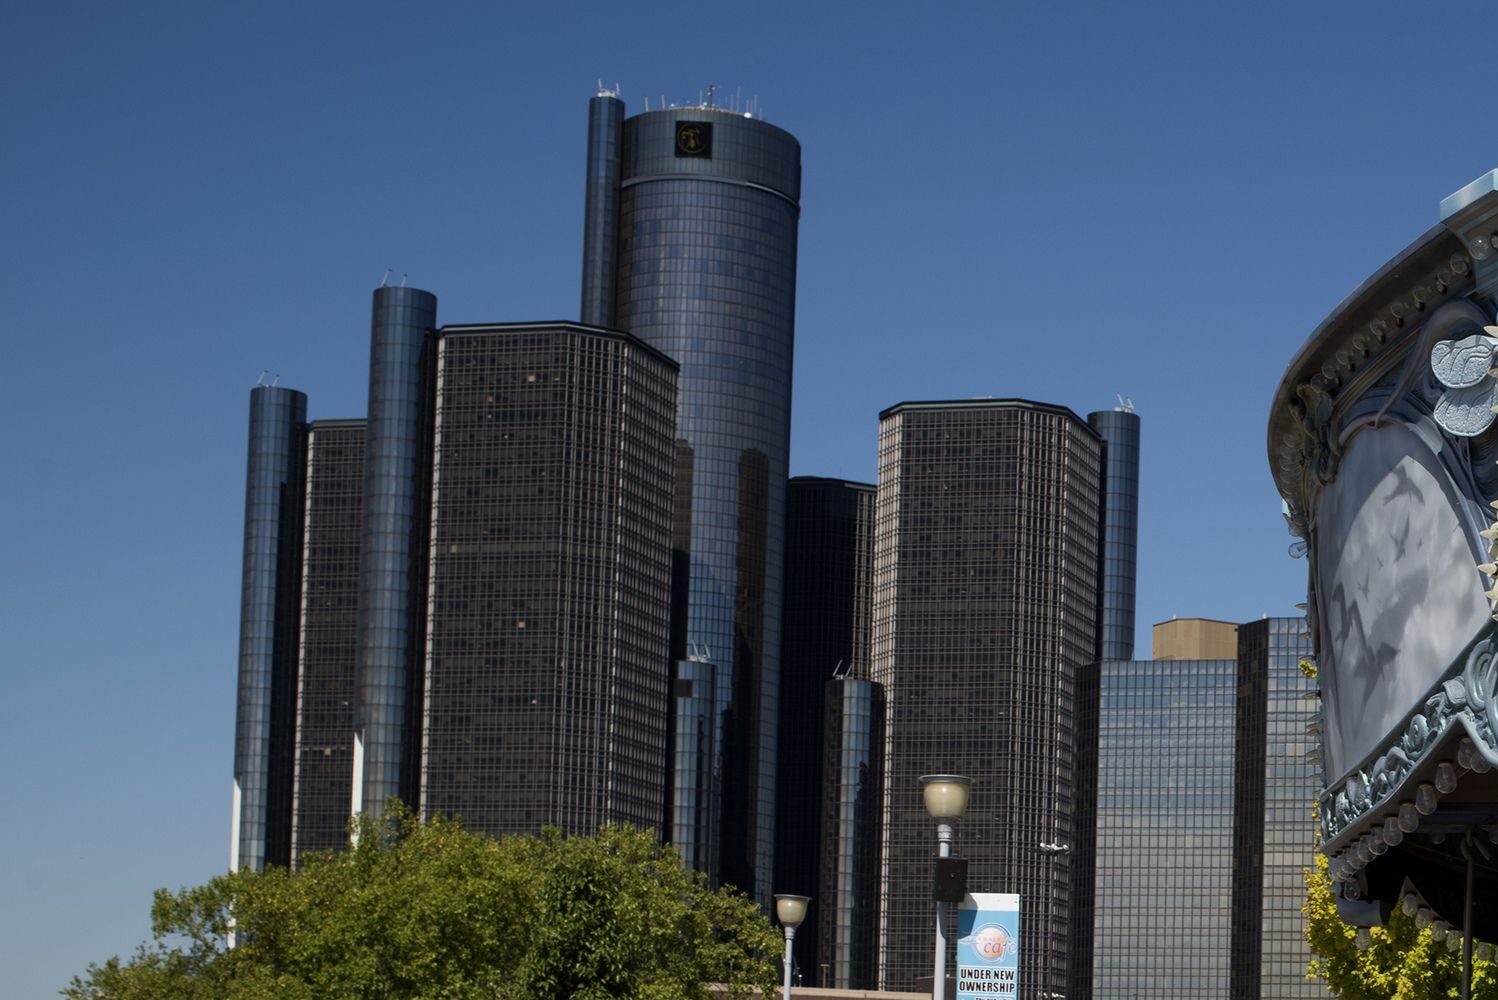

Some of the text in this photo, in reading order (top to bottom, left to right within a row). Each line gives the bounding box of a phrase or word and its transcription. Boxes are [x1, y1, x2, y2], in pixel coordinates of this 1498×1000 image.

[960, 968, 1015, 980] UNDER NEW
[959, 981, 1015, 992] OWNERSHIP
